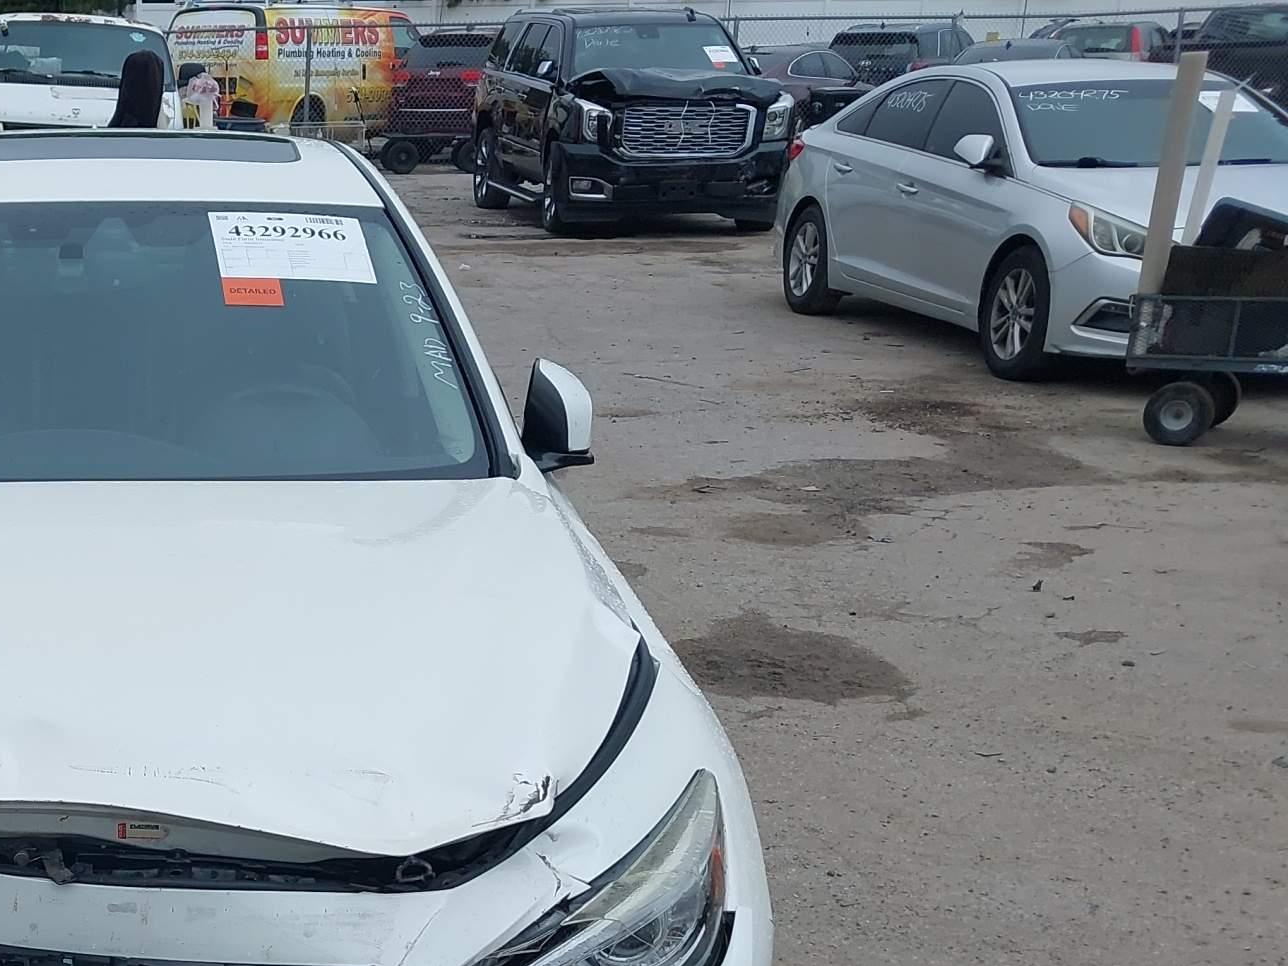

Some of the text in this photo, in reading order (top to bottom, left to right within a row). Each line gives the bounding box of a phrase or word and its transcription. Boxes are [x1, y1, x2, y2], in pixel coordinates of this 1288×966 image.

[274, 17, 380, 45] SUMMERS
[316, 48, 346, 59] Heating
[348, 49, 353, 57] &
[355, 48, 382, 59] Cooling
[228, 225, 347, 242] 43292966
[229, 287, 276, 295] DETAILED
